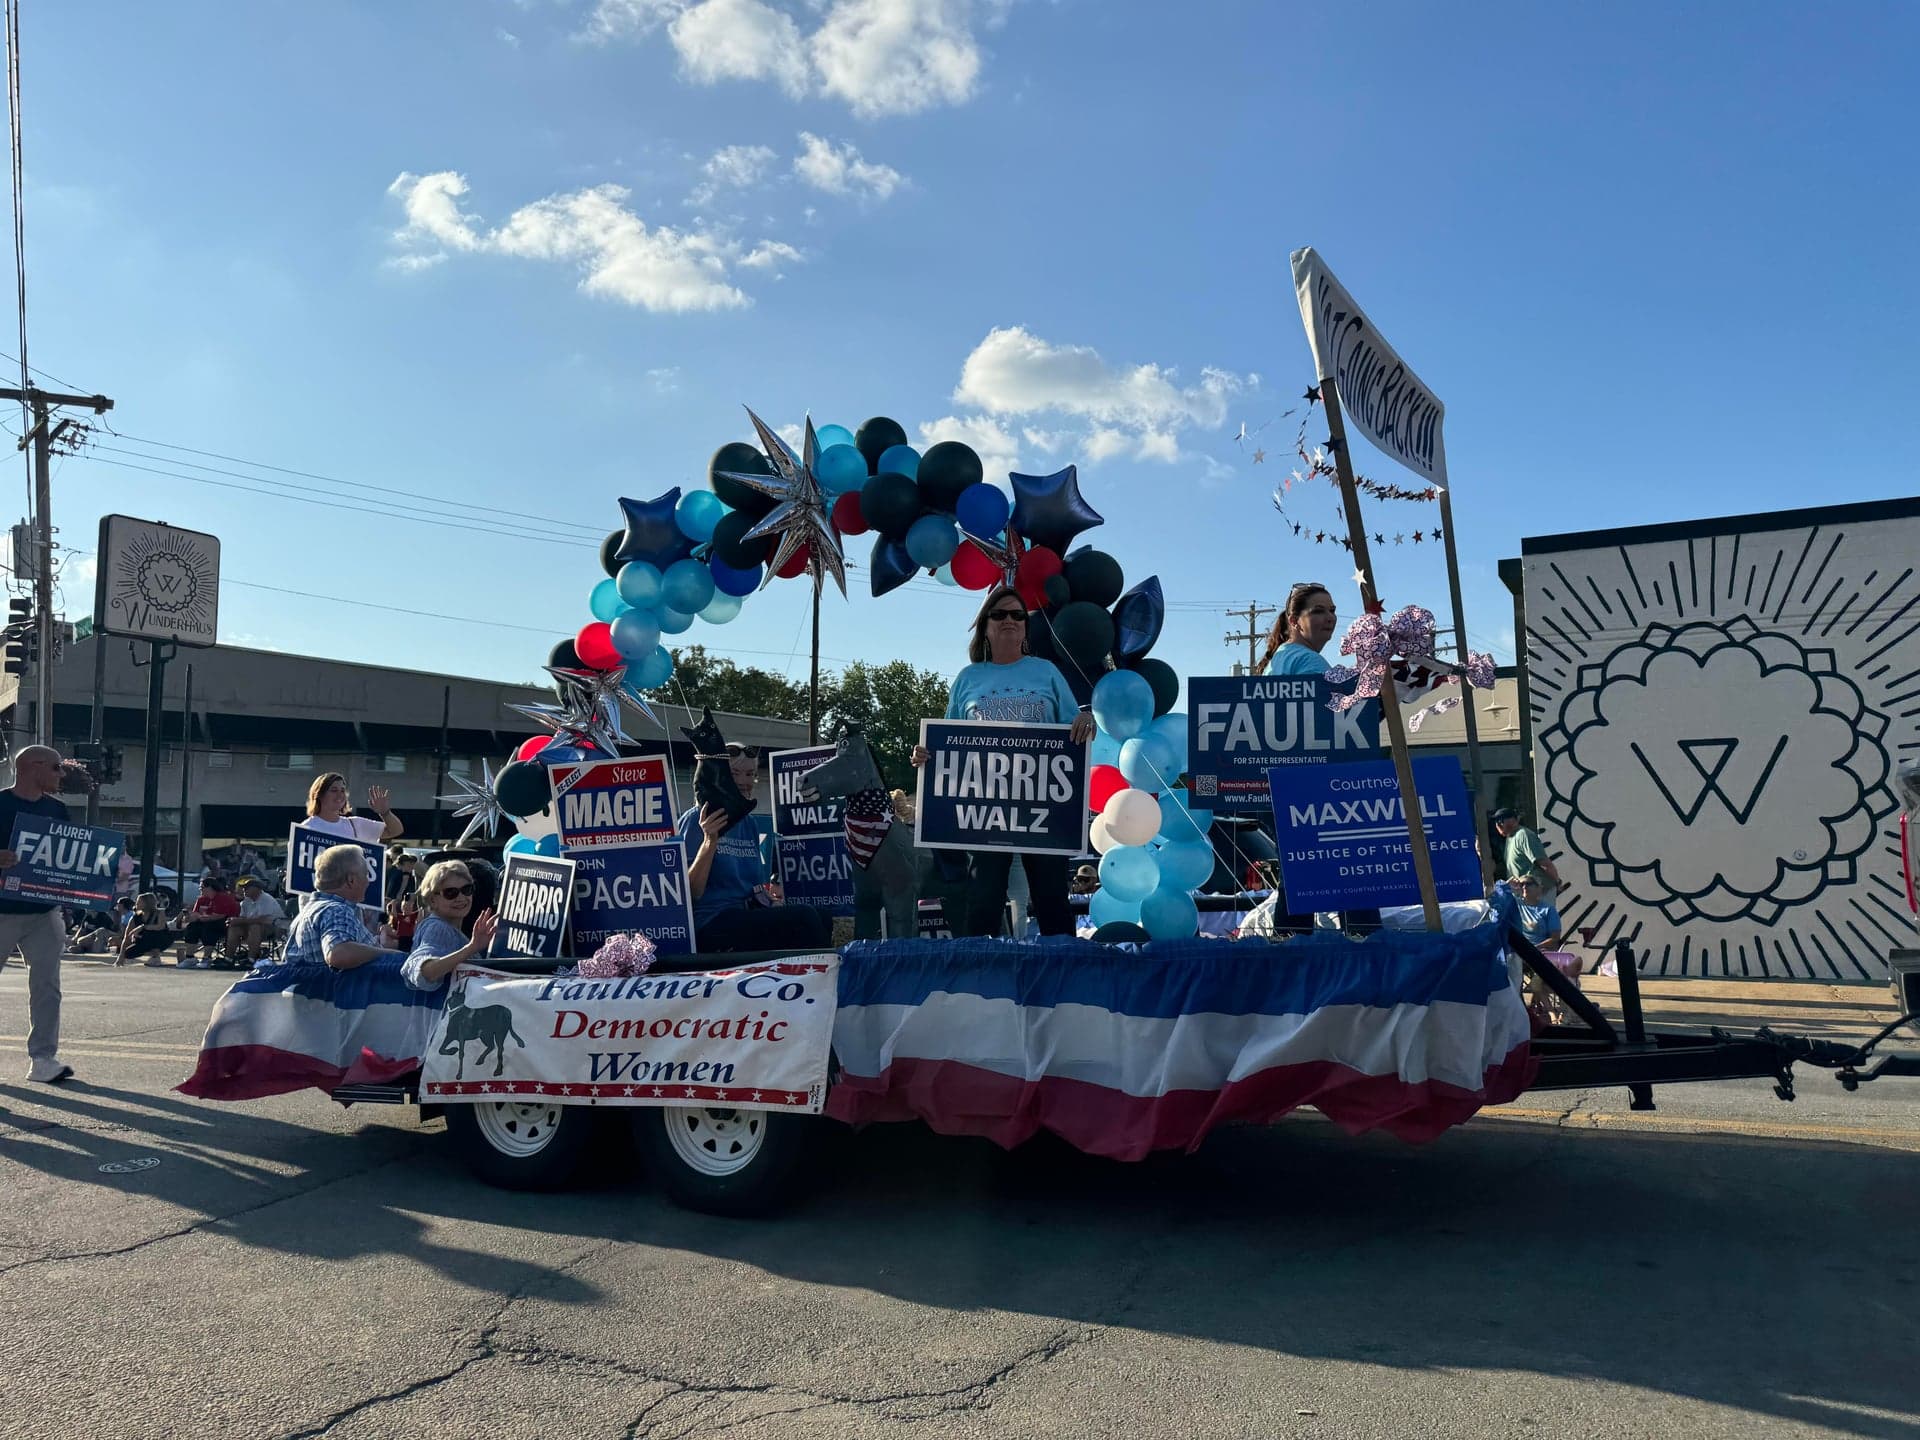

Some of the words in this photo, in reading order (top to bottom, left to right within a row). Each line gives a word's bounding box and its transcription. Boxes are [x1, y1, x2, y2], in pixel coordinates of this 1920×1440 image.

[1336, 316, 1386, 430] GOING
[1375, 360, 1440, 471] BACK!!!
[1242, 681, 1316, 699] LAUREN
[1198, 700, 1370, 752] FAULK
[946, 736, 998, 746] FAULKNER
[1001, 738, 1043, 749] COUNTY
[1044, 739, 1064, 749] FOR
[782, 760, 807, 769] FAULKNER
[1233, 757, 1247, 765] FOR
[1247, 757, 1269, 765] STATE
[1269, 756, 1327, 764] REPRESENTATIVE
[557, 769, 582, 794] RE-ELECT
[612, 766, 647, 783] Steve
[933, 750, 1074, 803] HARRIS
[1330, 775, 1400, 792] Courtney
[564, 787, 663, 829] MAGIE
[1224, 793, 1272, 803] www.Faulk
[791, 804, 838, 825] WALZ
[955, 804, 1050, 834] WALZ
[49, 823, 93, 841] LAUREN
[566, 836, 593, 847] STATE
[595, 831, 672, 845] REPRESENTATIVE
[15, 831, 117, 877] FAULK
[782, 841, 806, 852] JOHN
[1288, 847, 1351, 862] JUSTICE
[1357, 846, 1377, 857] OF
[1383, 843, 1412, 855] THE
[1430, 839, 1469, 851] EACE
[576, 858, 606, 870] OHN
[783, 854, 853, 882] PAGAN
[1339, 862, 1410, 876] DISTRICT
[536, 870, 553, 880] COUNTY
[553, 873, 563, 882] FOR
[573, 872, 683, 911] PAGAN
[789, 896, 811, 905] STATE
[812, 895, 855, 905] TREASURE
[502, 879, 563, 932] HARRIS
[507, 927, 547, 957] WALZ
[576, 930, 611, 943] STATE
[534, 976, 725, 1001] Faulkner
[737, 974, 816, 1004] Co.
[550, 1010, 788, 1042] Democratic
[587, 1052, 736, 1083] Women
